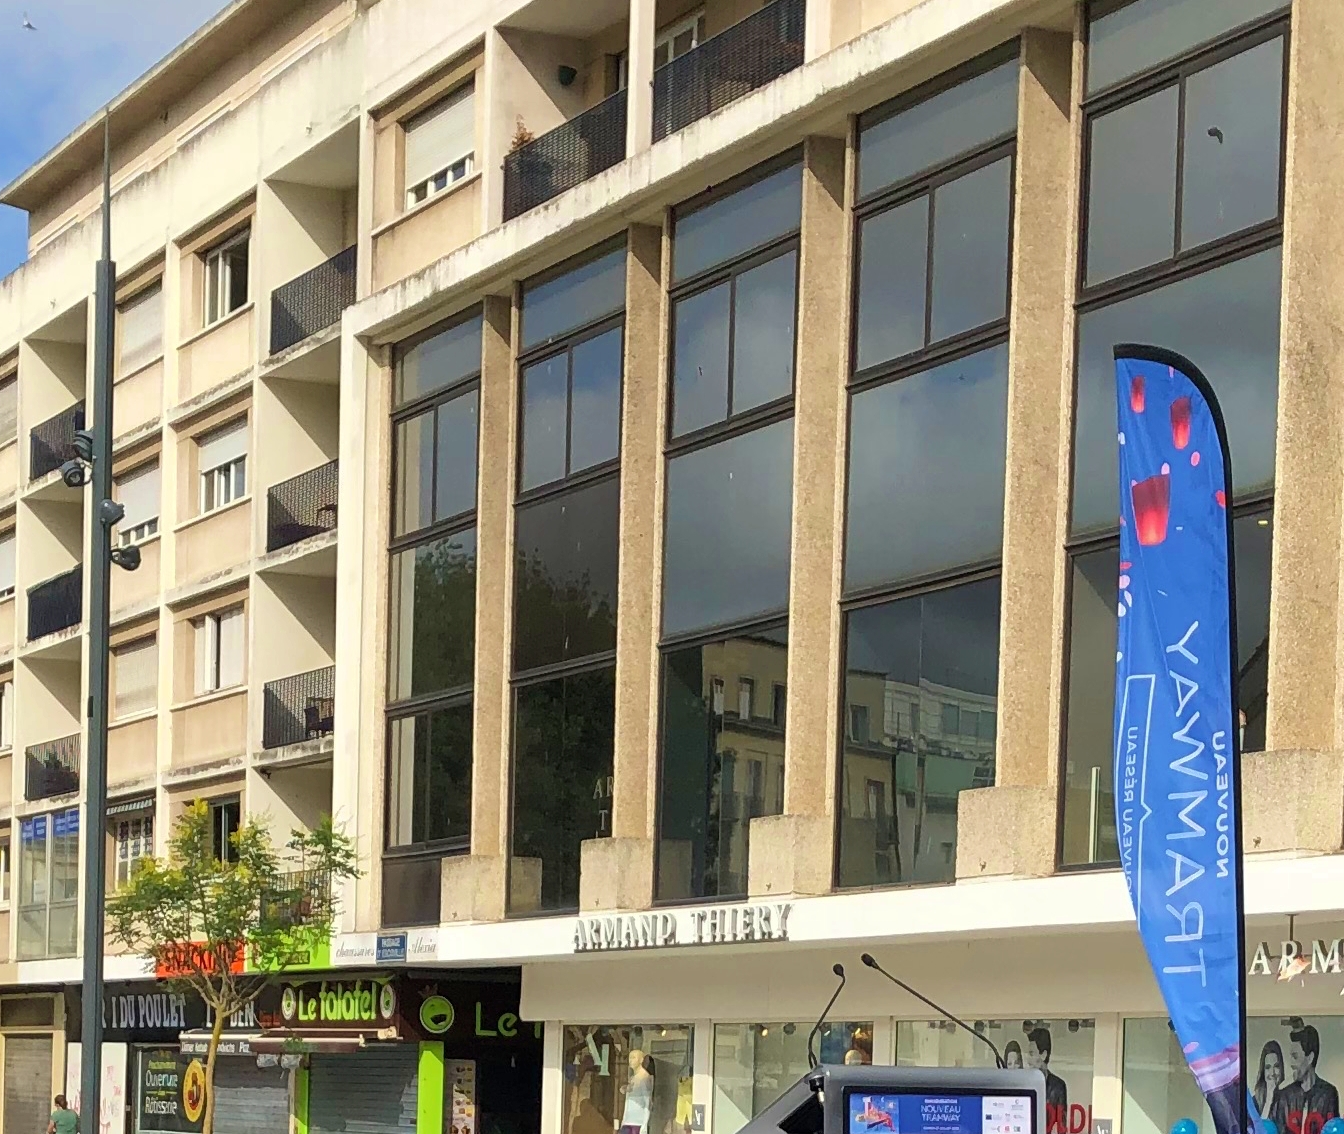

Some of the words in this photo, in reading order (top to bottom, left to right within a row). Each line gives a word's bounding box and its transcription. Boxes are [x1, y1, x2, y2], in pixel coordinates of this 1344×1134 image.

[573, 913, 677, 948] ARMAND
[691, 904, 792, 940] THIERY
[298, 990, 317, 1021] Le
[475, 1001, 518, 1038] Le
[920, 1105, 961, 1114] NOUVEAU
[921, 1113, 961, 1122] TRAMWAY
